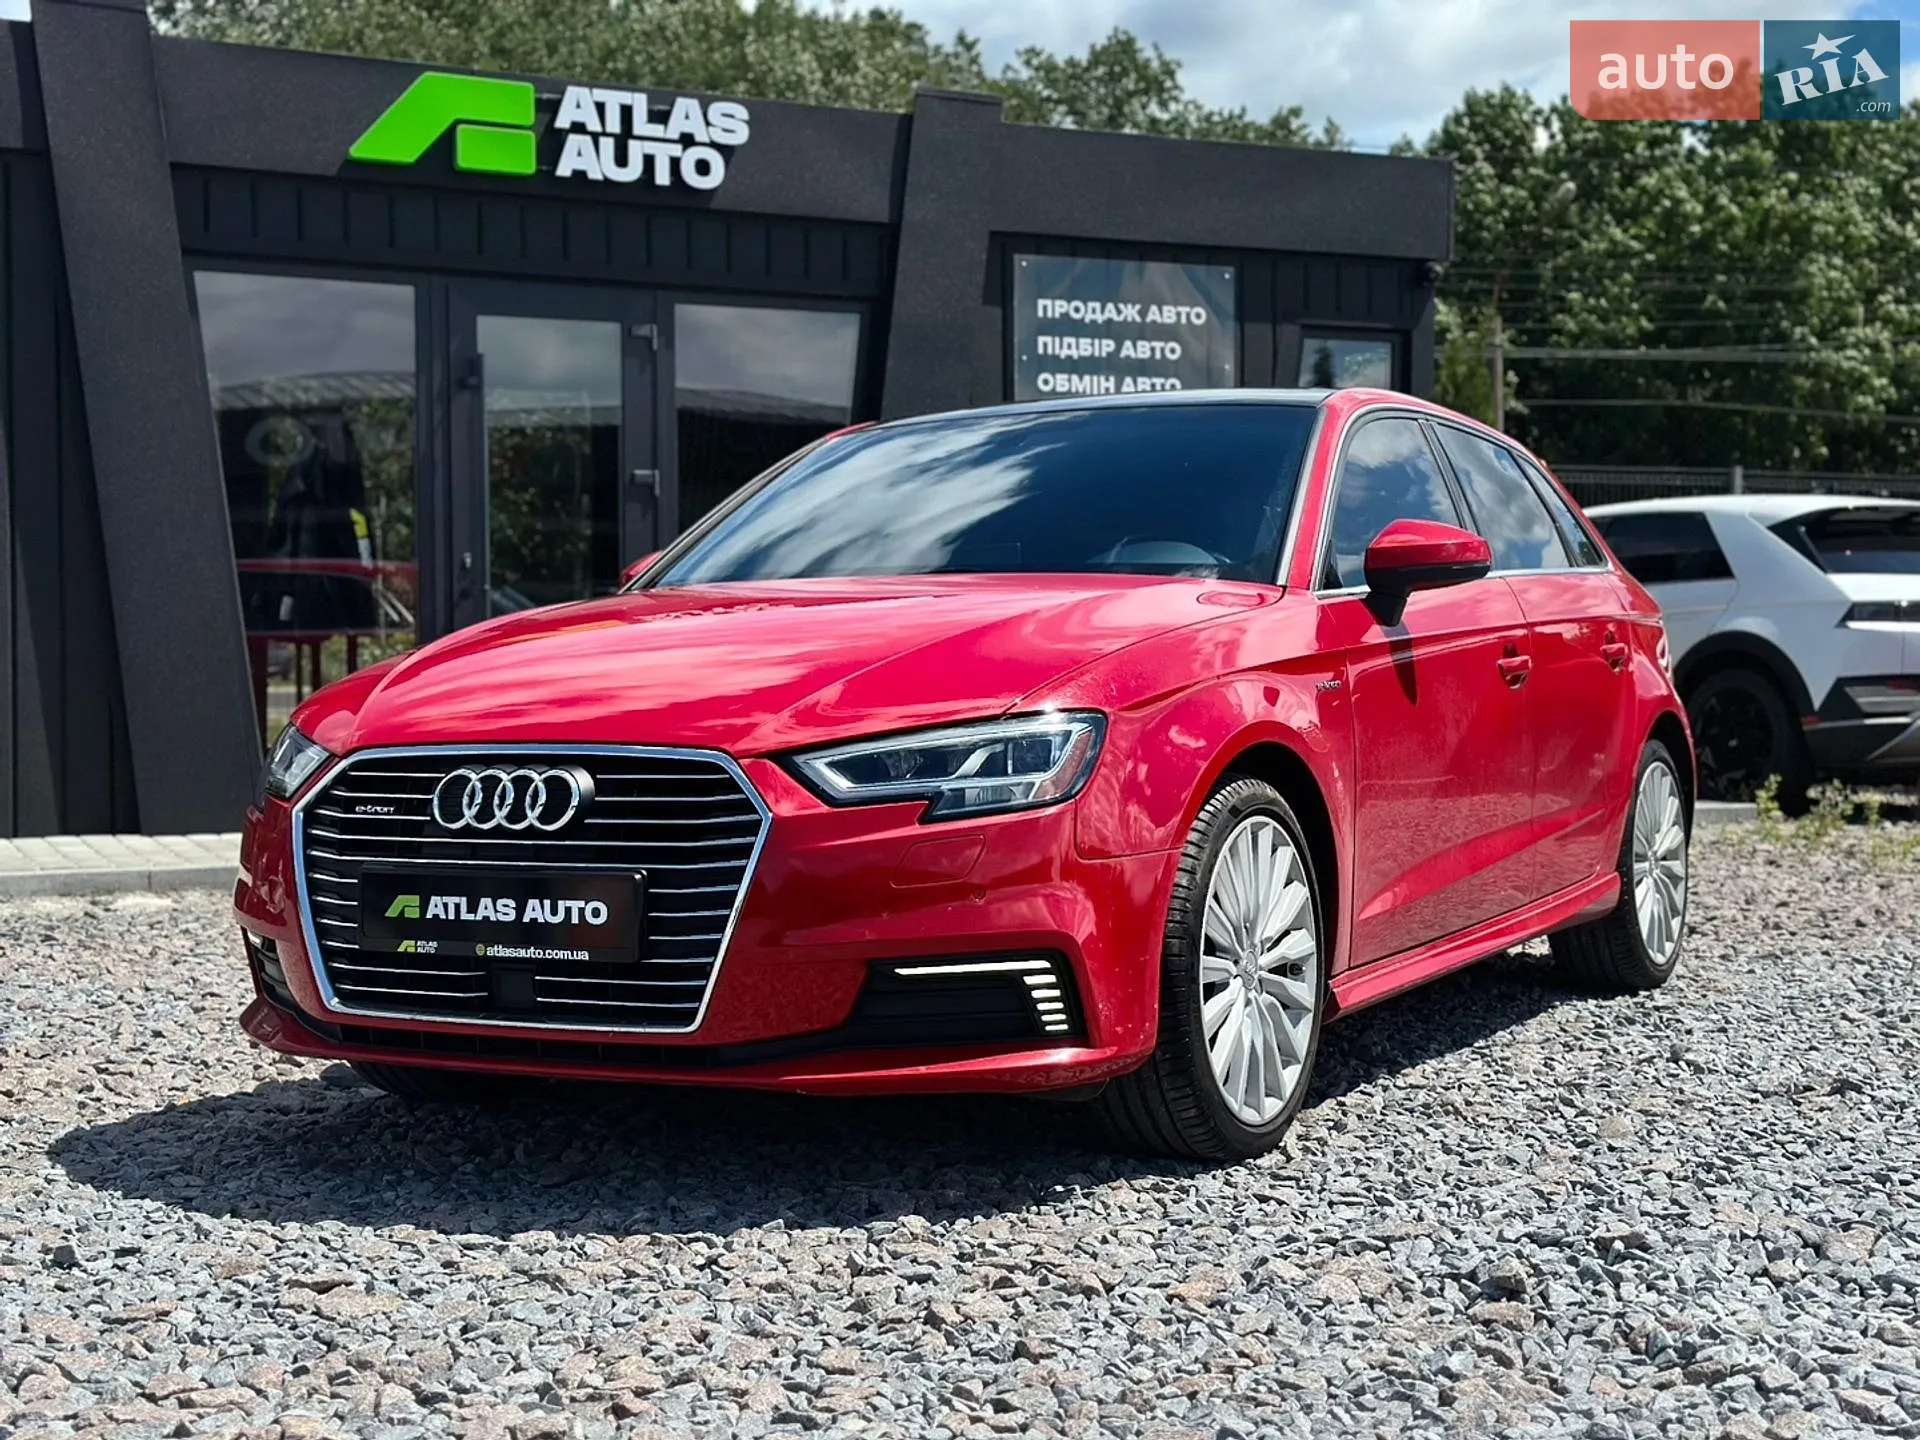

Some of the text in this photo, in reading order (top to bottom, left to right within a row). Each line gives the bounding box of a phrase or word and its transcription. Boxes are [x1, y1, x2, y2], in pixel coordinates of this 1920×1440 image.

[553, 85, 750, 146] ATLAS
[554, 132, 726, 190] AUTO
[1036, 298, 1207, 326] ПРОДАЖ АВТО
[1036, 335, 1182, 361] ПІДБІР АВТО
[1036, 372, 1182, 395] ОБМІН АВТО
[425, 895, 609, 926] ATLAS AUTO
[485, 943, 590, 961] atlasauto.com.ua
